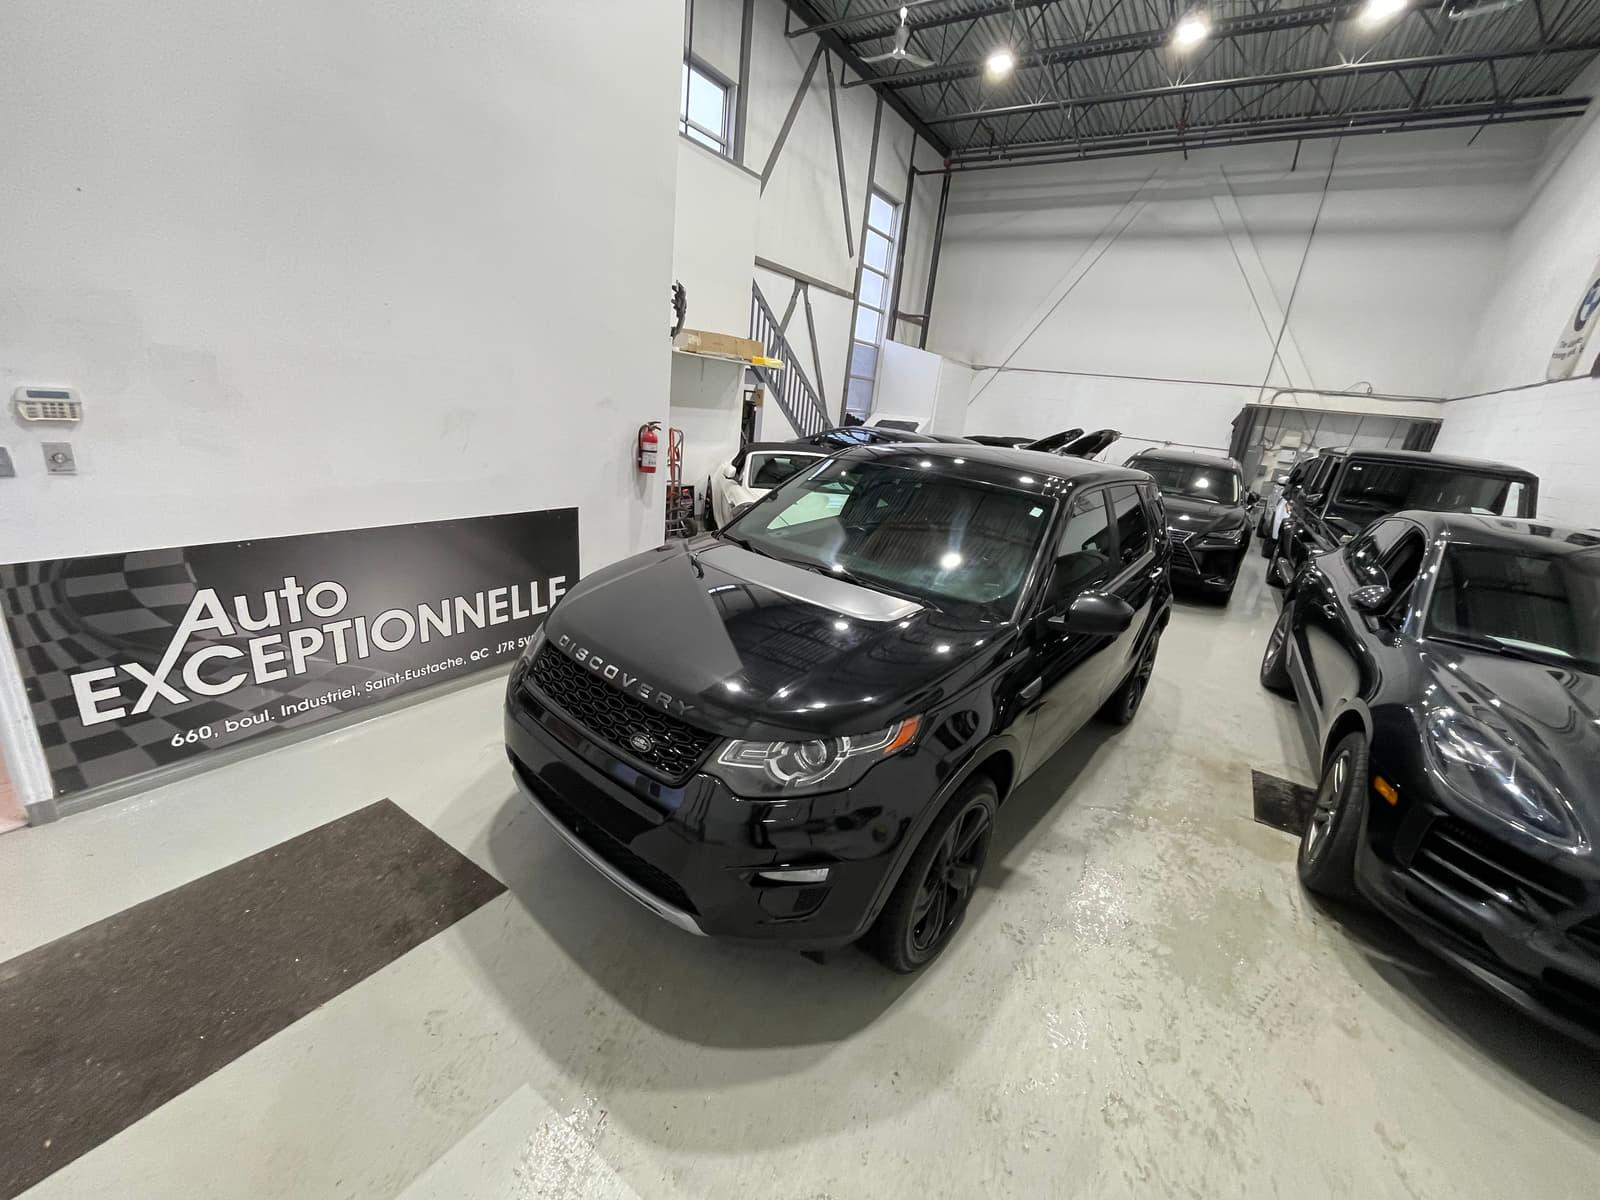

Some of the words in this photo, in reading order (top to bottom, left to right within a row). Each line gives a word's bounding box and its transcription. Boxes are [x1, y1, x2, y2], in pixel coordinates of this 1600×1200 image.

[70, 576, 566, 726] EXCEPTIONNELLE
[174, 576, 348, 638] Auto
[170, 726, 218, 748] 660,
[224, 709, 275, 732] boul.
[280, 685, 361, 717] Industriel,
[365, 656, 467, 692] Saint-Eustache,
[470, 648, 489, 661] QC
[495, 640, 515, 654] J7R
[518, 634, 535, 647] 5V
[559, 634, 695, 715] DISCOVERY
